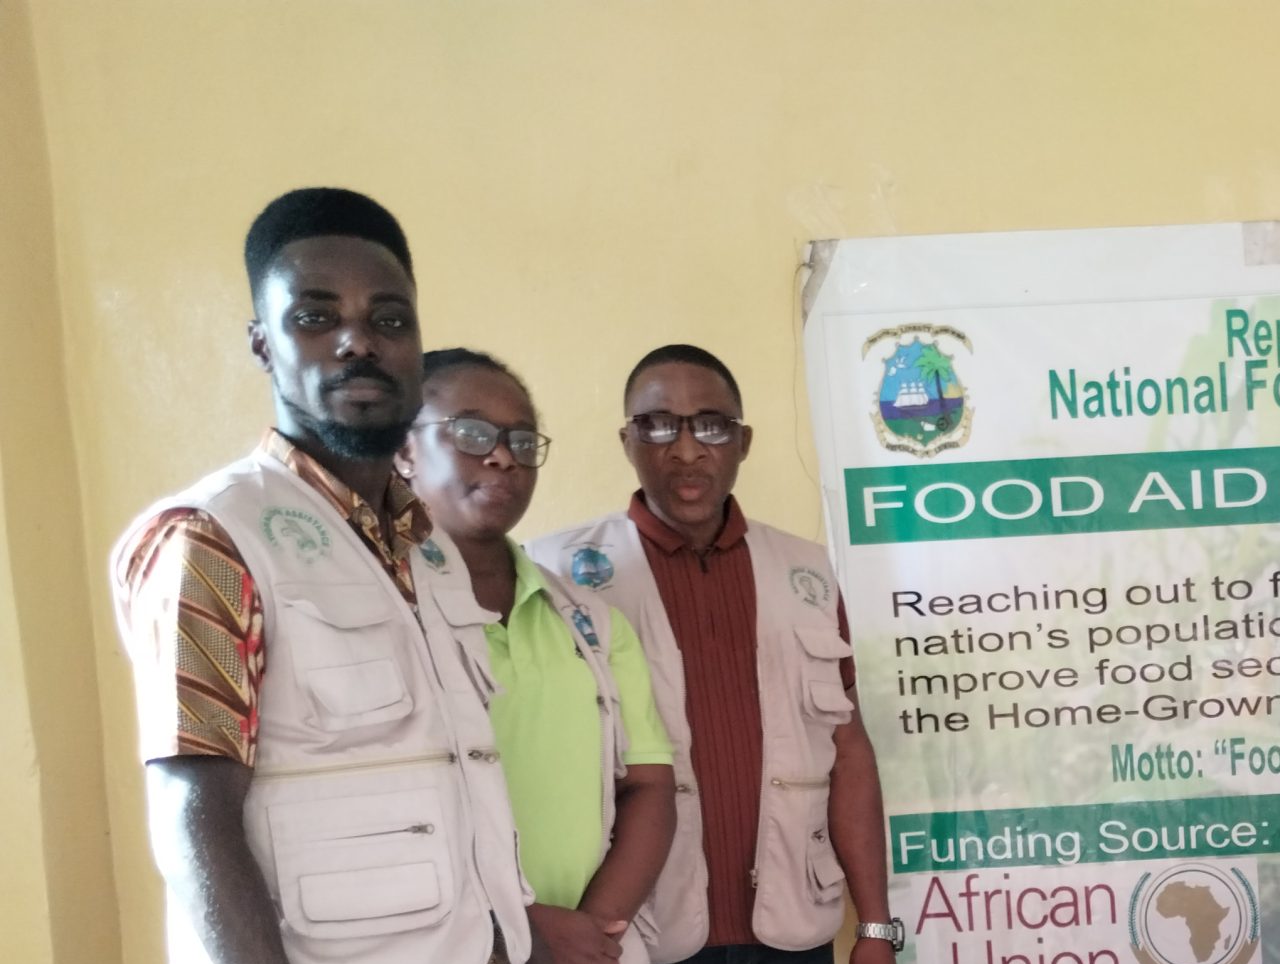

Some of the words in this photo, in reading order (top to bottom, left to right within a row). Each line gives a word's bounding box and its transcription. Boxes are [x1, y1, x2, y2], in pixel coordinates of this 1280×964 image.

[1049, 361, 1227, 420] National
[863, 477, 1105, 527] FOOD
[1128, 467, 1268, 513] AID
[891, 583, 1108, 618] Reaching
[1125, 577, 1197, 606] out
[1213, 574, 1254, 601] to
[898, 664, 1080, 701] improve
[1097, 655, 1194, 686] food
[900, 706, 970, 734] the
[1112, 741, 1204, 782] Motto:
[899, 825, 1081, 864] Funding
[1099, 820, 1270, 855] Source:
[916, 872, 1118, 935] African
